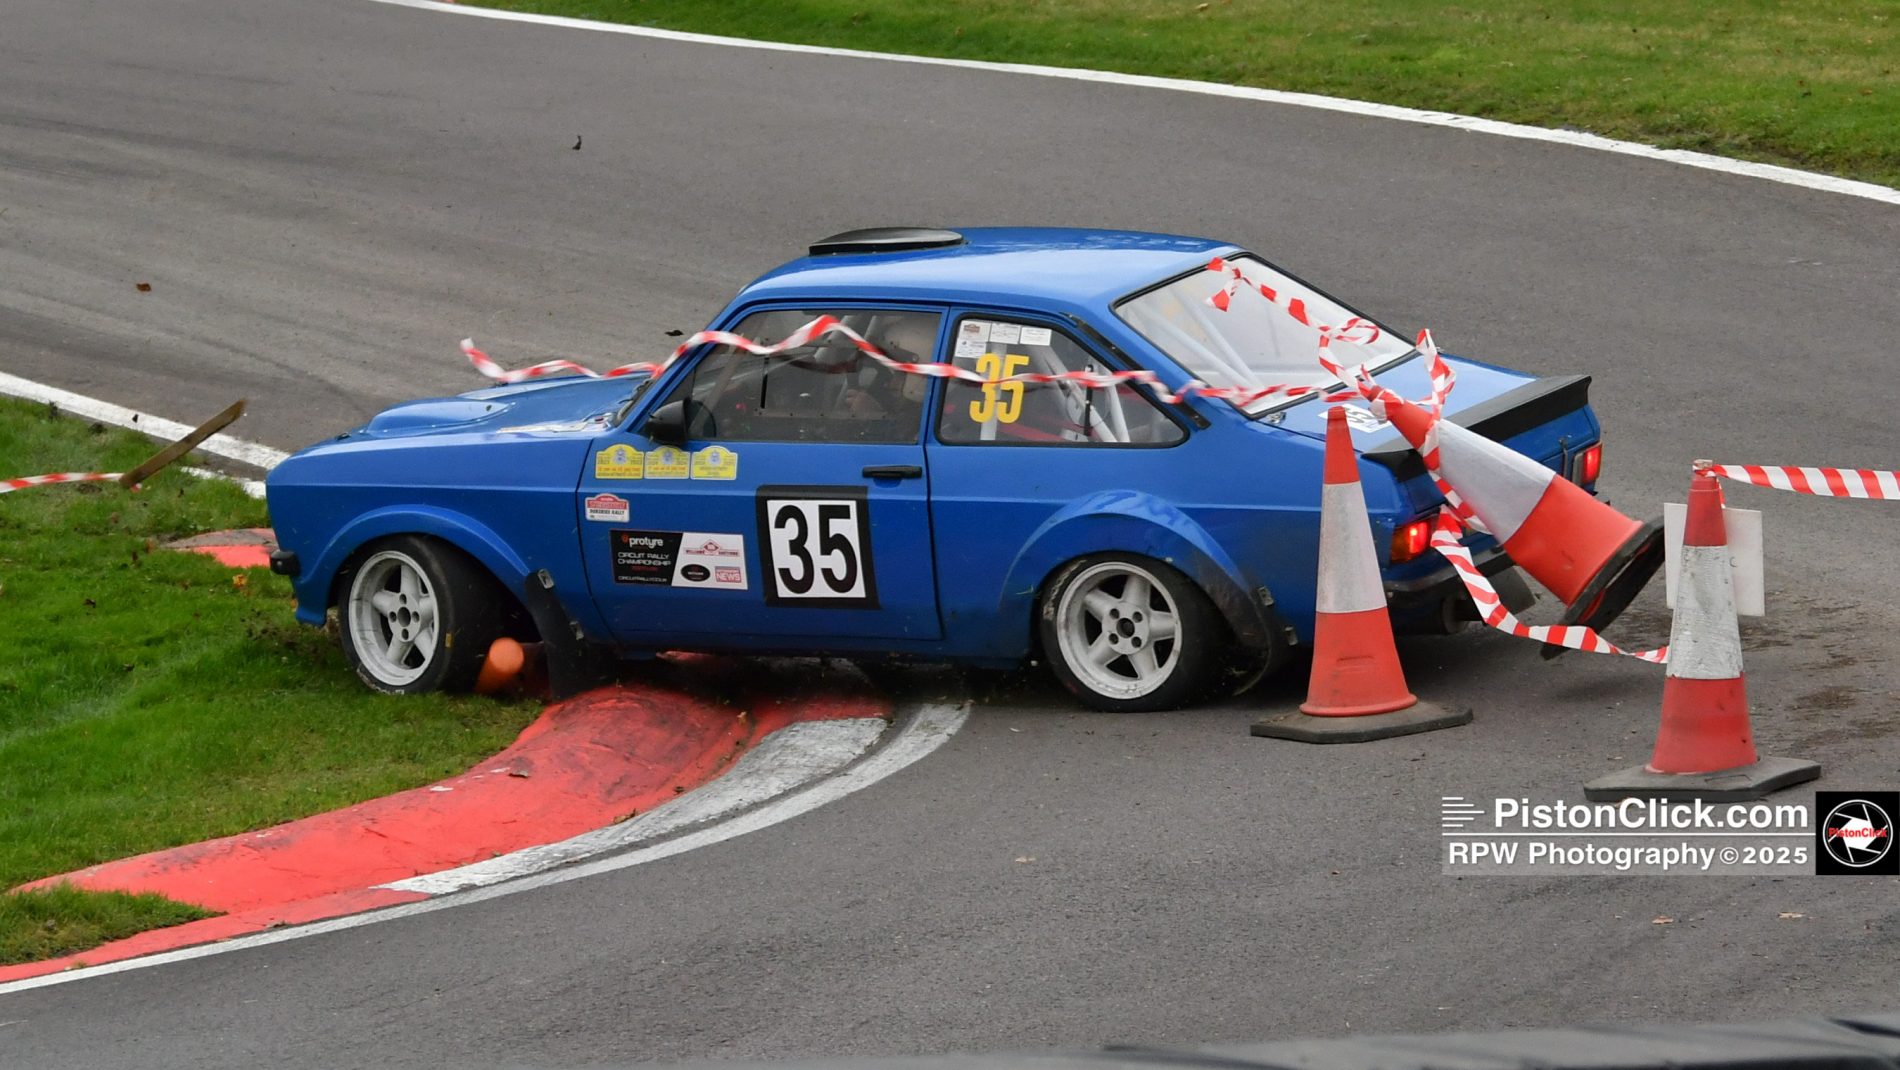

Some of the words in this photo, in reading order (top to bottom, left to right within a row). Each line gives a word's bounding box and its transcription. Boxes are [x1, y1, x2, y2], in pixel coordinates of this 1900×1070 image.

[969, 353, 1030, 424] 35
[629, 537, 664, 549] protyre
[774, 504, 858, 594] 35
[716, 572, 740, 582] NEWS
